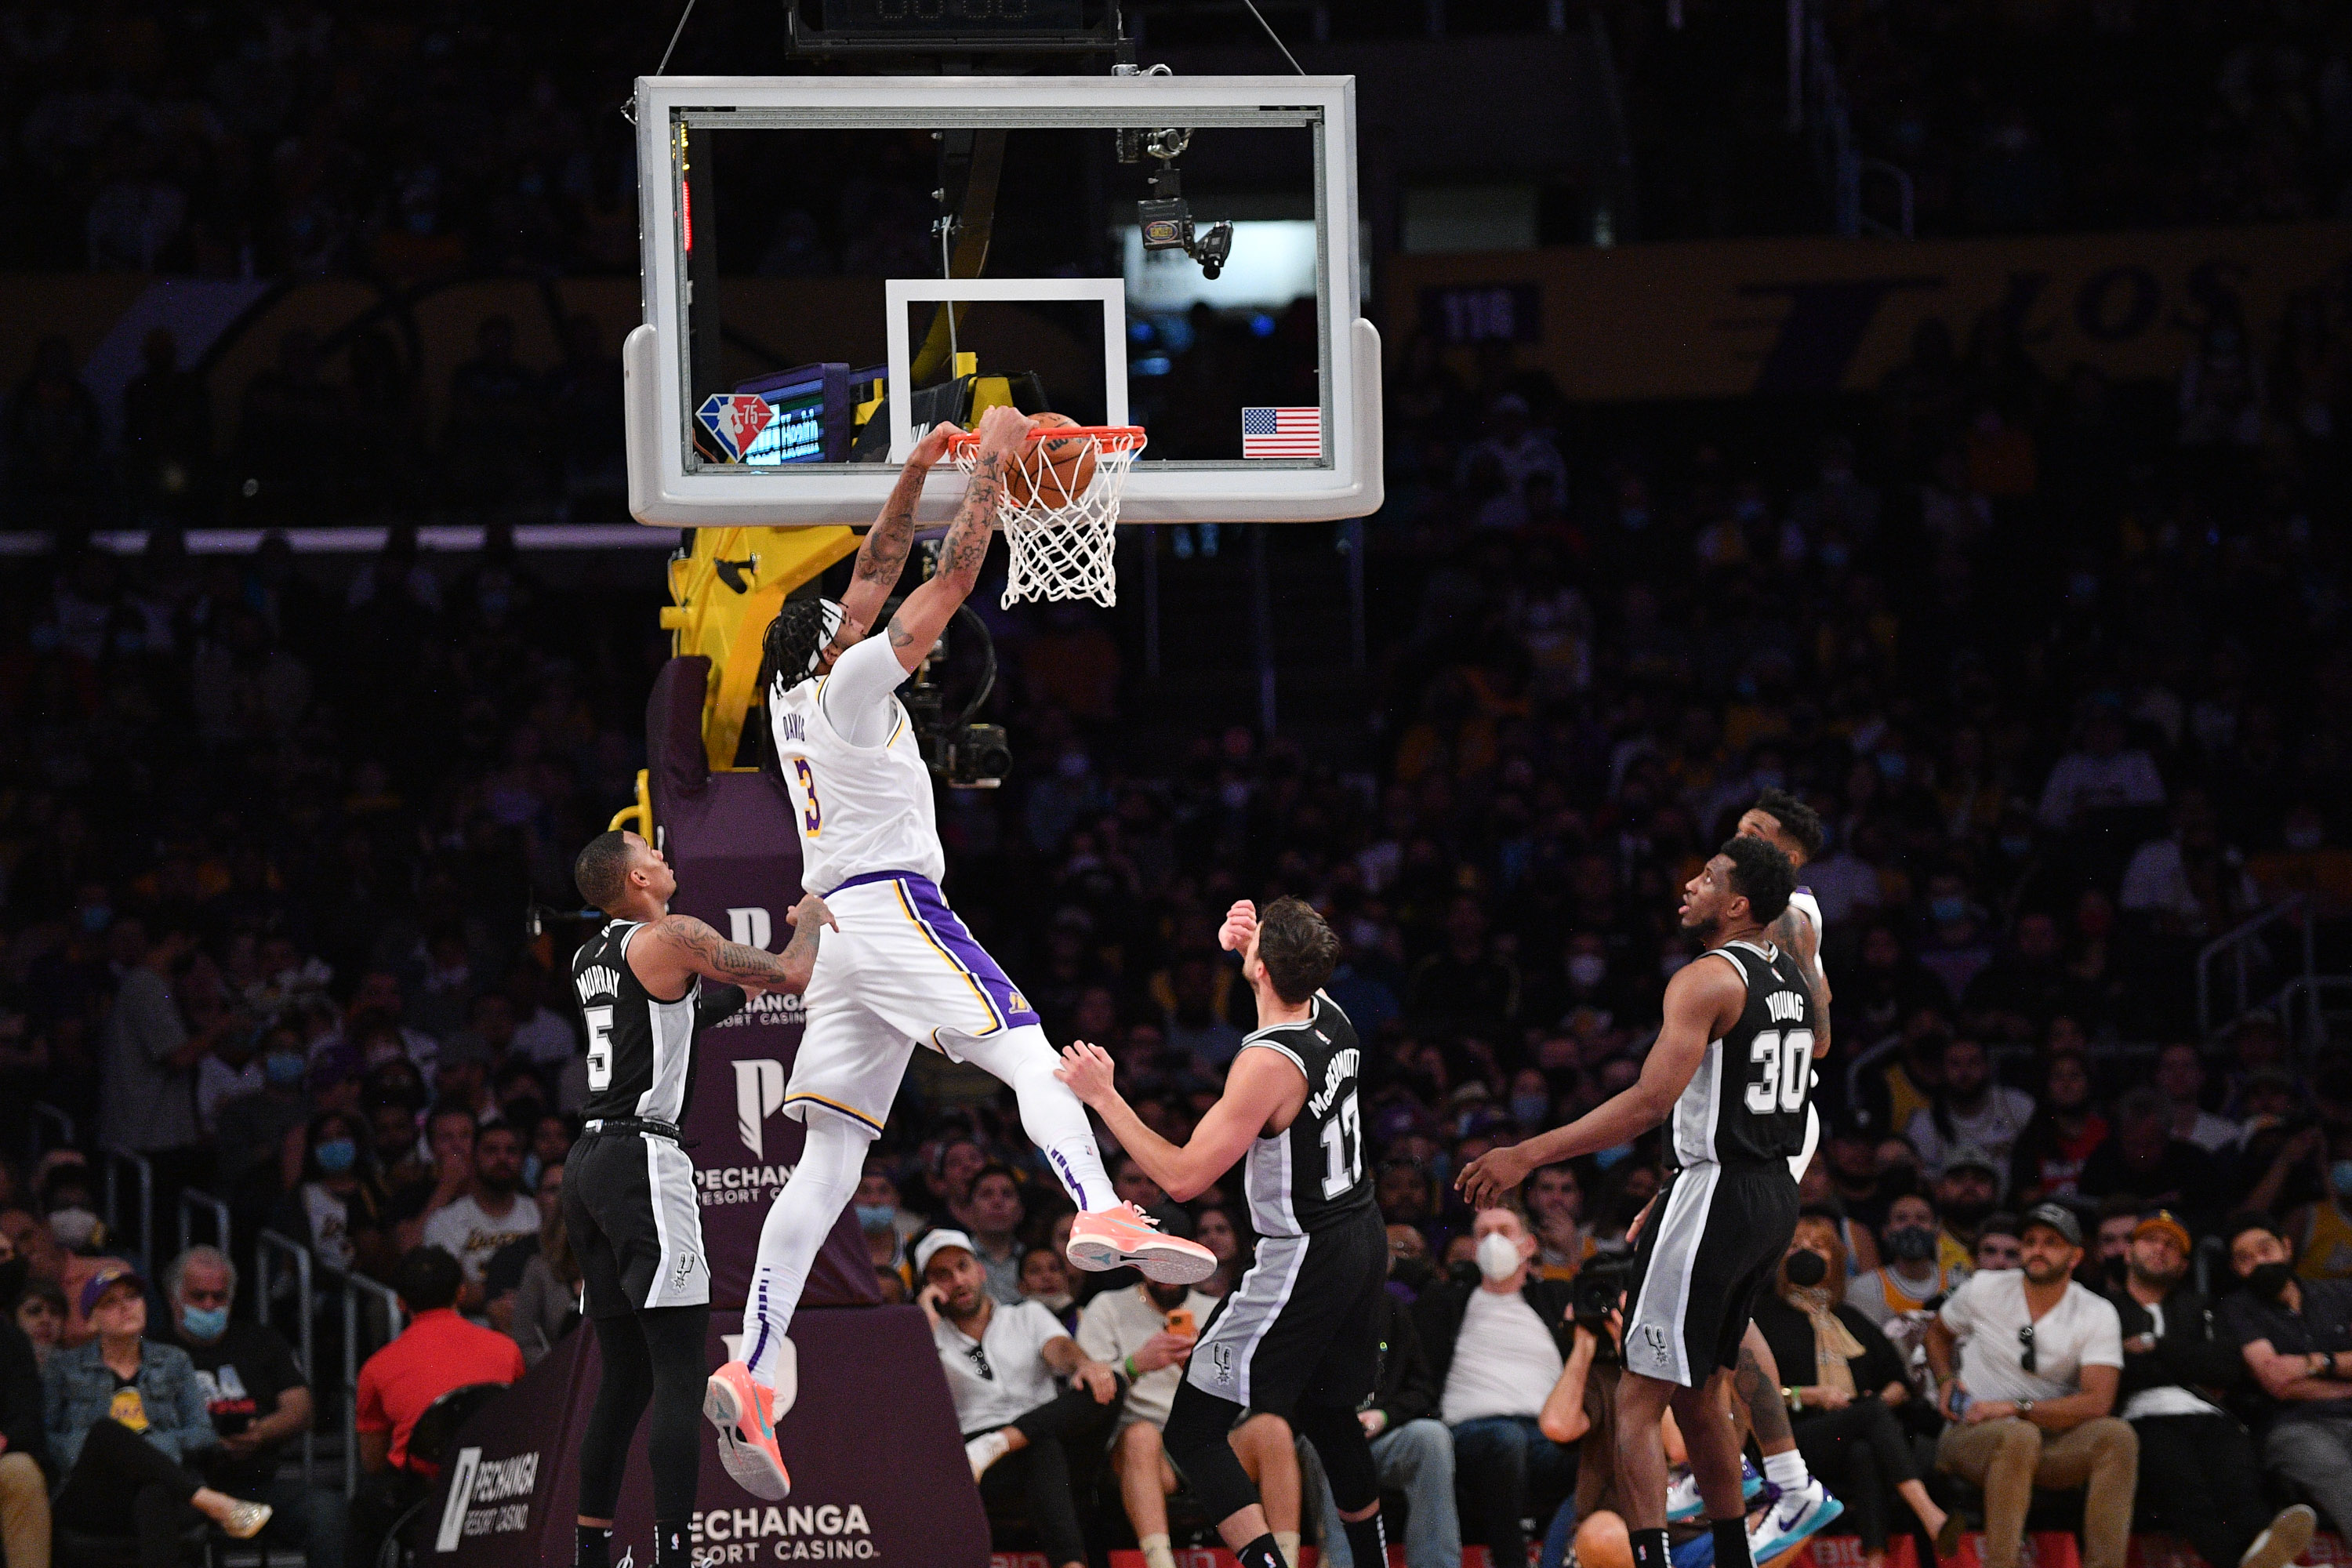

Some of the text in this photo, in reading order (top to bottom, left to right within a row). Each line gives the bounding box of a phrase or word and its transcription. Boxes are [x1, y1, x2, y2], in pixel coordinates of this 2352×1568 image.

[743, 405, 757, 424] 75
[782, 713, 805, 742] DAVIS
[793, 757, 822, 837] 3
[576, 964, 620, 1004] MURRAY
[760, 1011, 806, 1025] CASIN
[1765, 990, 1803, 1023] YOUNG
[583, 1004, 614, 1092] 5
[1744, 1028, 1815, 1115] 30
[1319, 1087, 1362, 1201] 17
[698, 1188, 760, 1206] ESORT
[690, 1504, 871, 1543] ECHANGA
[774, 1539, 874, 1561] CASINO
